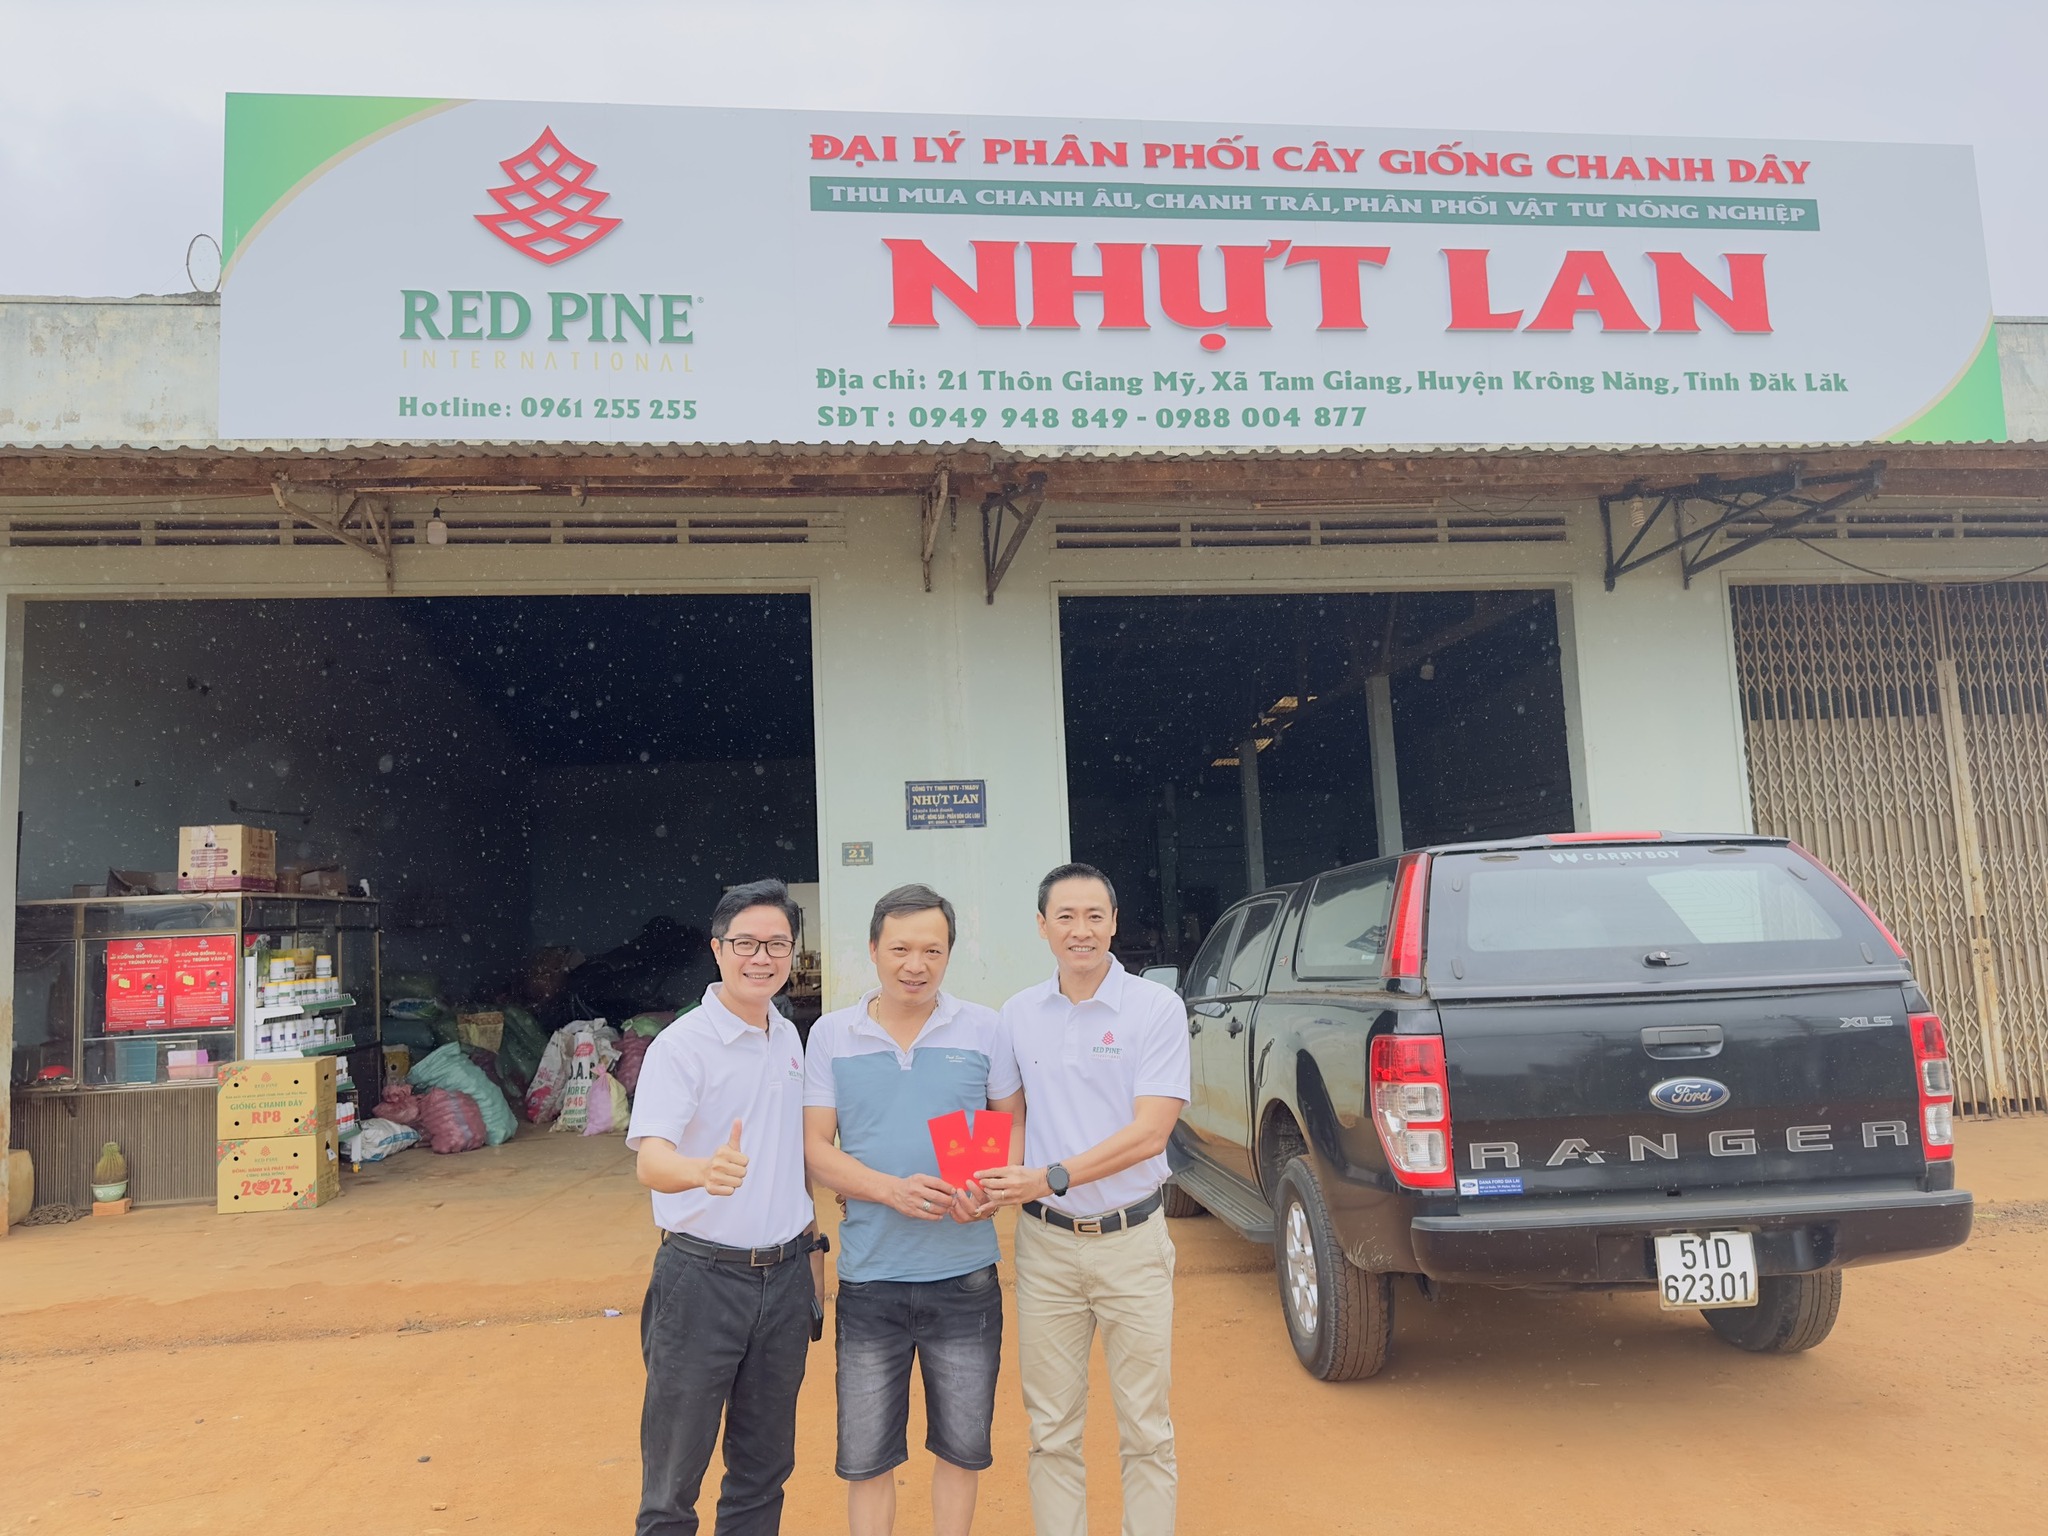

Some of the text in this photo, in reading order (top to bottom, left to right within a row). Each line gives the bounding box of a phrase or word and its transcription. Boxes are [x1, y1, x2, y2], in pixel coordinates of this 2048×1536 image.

[809, 130, 1811, 184] ĐẠI LÝ PHÂN PHỐI CÂY GIỐNG CHANH DÂY
[827, 185, 1806, 225] THU MUA CHANH ÂU, CHANH TRÁI, PHÂN PHỐI VẬT TƯ NÔNG NGHIỆP
[882, 238, 1774, 352] NHỰT LAN
[400, 289, 532, 340] RED
[403, 350, 694, 373] INTERNATIONAL
[815, 368, 1849, 396] Địa chỉ: 21 Thôn Giang Mỹ, Xã Tam Giang, Huyện Krông Năng, Tỉnh Đăk Lăk
[398, 396, 698, 421] Hotline: 0961 255 255
[908, 406, 988, 429] 0949
[1001, 407, 1060, 429] 948
[1070, 408, 1128, 430] 849
[1155, 407, 1231, 429] 0988
[1241, 407, 1301, 429] 004
[1313, 406, 1368, 428] 877
[912, 793, 979, 807] NHỰT LAN
[848, 849, 867, 858] 21
[1582, 850, 1680, 861] CARRYBOY
[1840, 1016, 1893, 1028] XLS
[258, 1100, 287, 1109] CHANH
[1671, 1083, 1713, 1104] Ford
[251, 1110, 281, 1124] RP8
[1468, 1119, 1909, 1170] RANGER
[1680, 1238, 1731, 1270] 51D
[1664, 1270, 1748, 1304] 623.01
